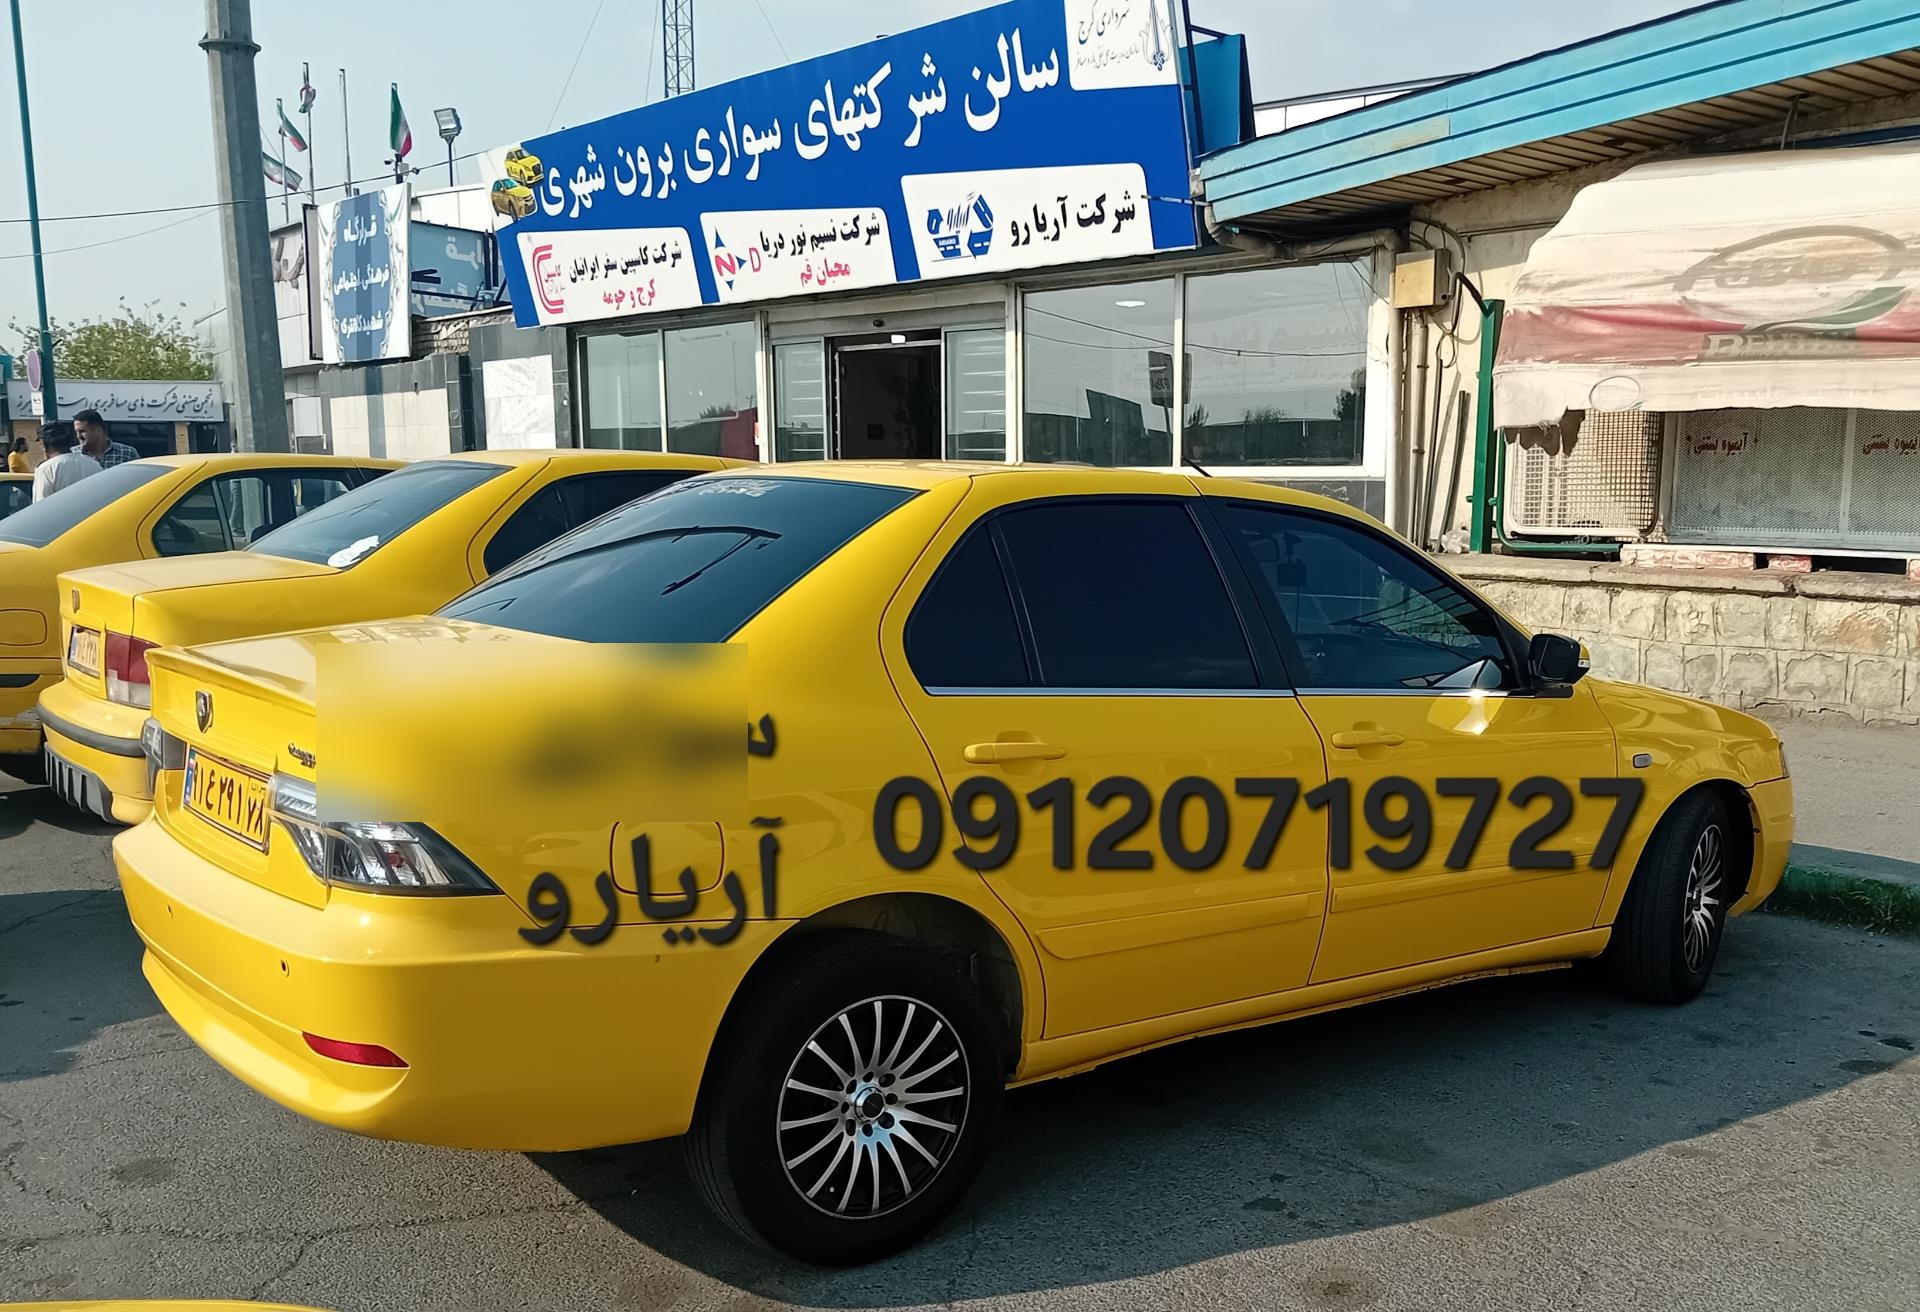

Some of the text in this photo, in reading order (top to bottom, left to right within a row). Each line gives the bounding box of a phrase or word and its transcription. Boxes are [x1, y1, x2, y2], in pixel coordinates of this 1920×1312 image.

[964, 27, 1060, 132] سالن
[684, 105, 782, 181] سواری
[540, 143, 606, 218] شهری
[613, 142, 678, 200] برون
[1076, 189, 1136, 234] شرکت
[343, 214, 378, 247] قرارگاه
[760, 212, 880, 258] شرکت نسیم نور دریا
[569, 240, 682, 283] شرکت کاسپین سفر ایرانیان
[800, 258, 850, 287] محبان قم
[603, 278, 656, 310] کرج و حومه
[362, 310, 384, 335] شهید
[128, 396, 145, 411] های
[147, 386, 177, 413] شرکت
[176, 394, 199, 413] صنفی
[193, 388, 213, 414] انجمن
